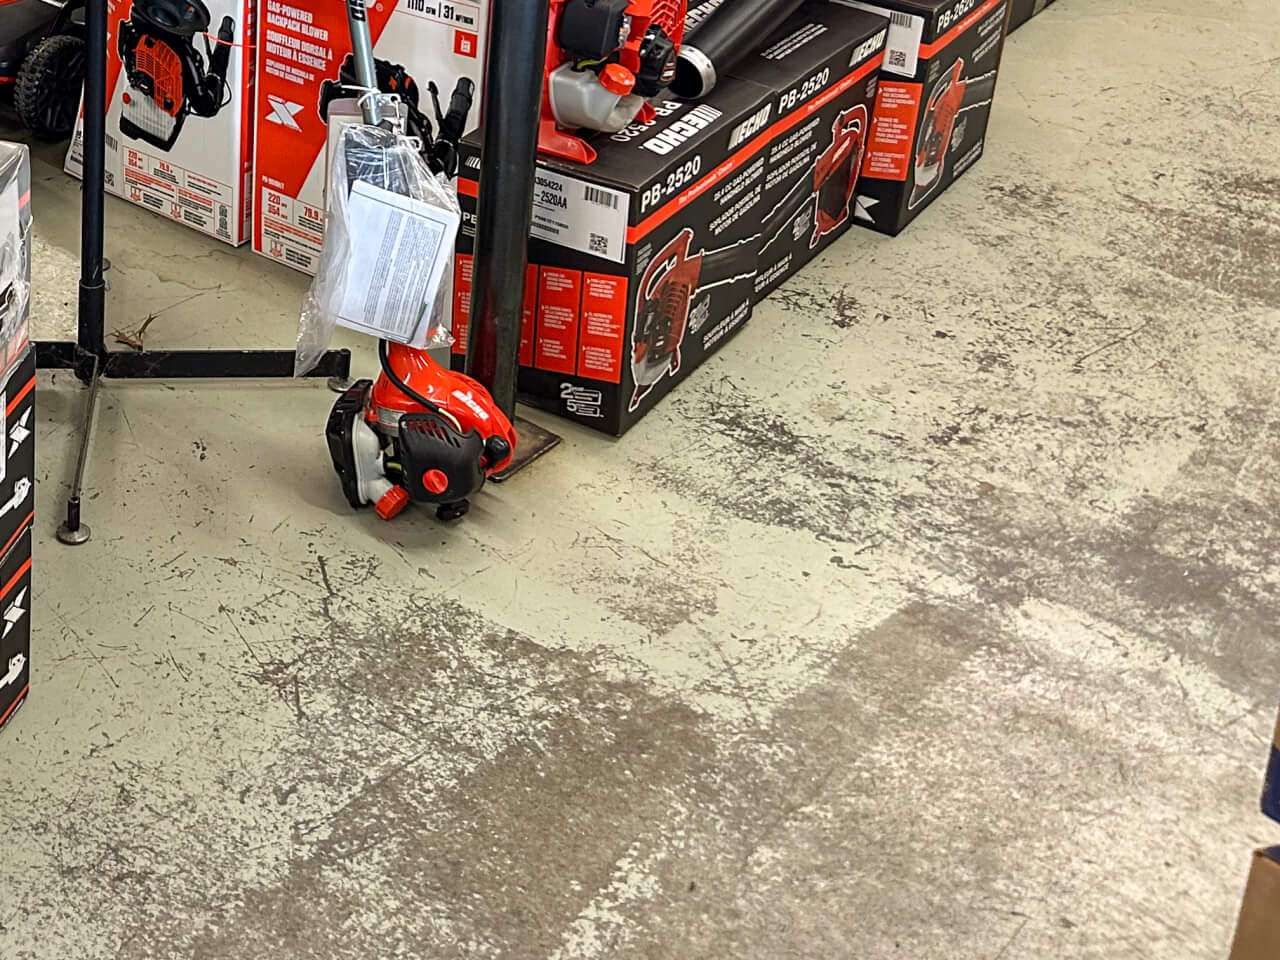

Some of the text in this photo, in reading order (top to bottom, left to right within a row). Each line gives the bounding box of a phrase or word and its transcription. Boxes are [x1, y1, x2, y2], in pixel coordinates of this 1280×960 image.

[267, 0, 313, 23] GAS-POWERED
[267, 12, 329, 41] BACKPACK BLOWER
[443, 5, 455, 20] 31
[854, 28, 887, 65] ECHO
[778, 67, 830, 115] PB-2520
[642, 104, 718, 156] ECHO
[734, 103, 771, 148] ECHO
[640, 156, 702, 213] PB-2520
